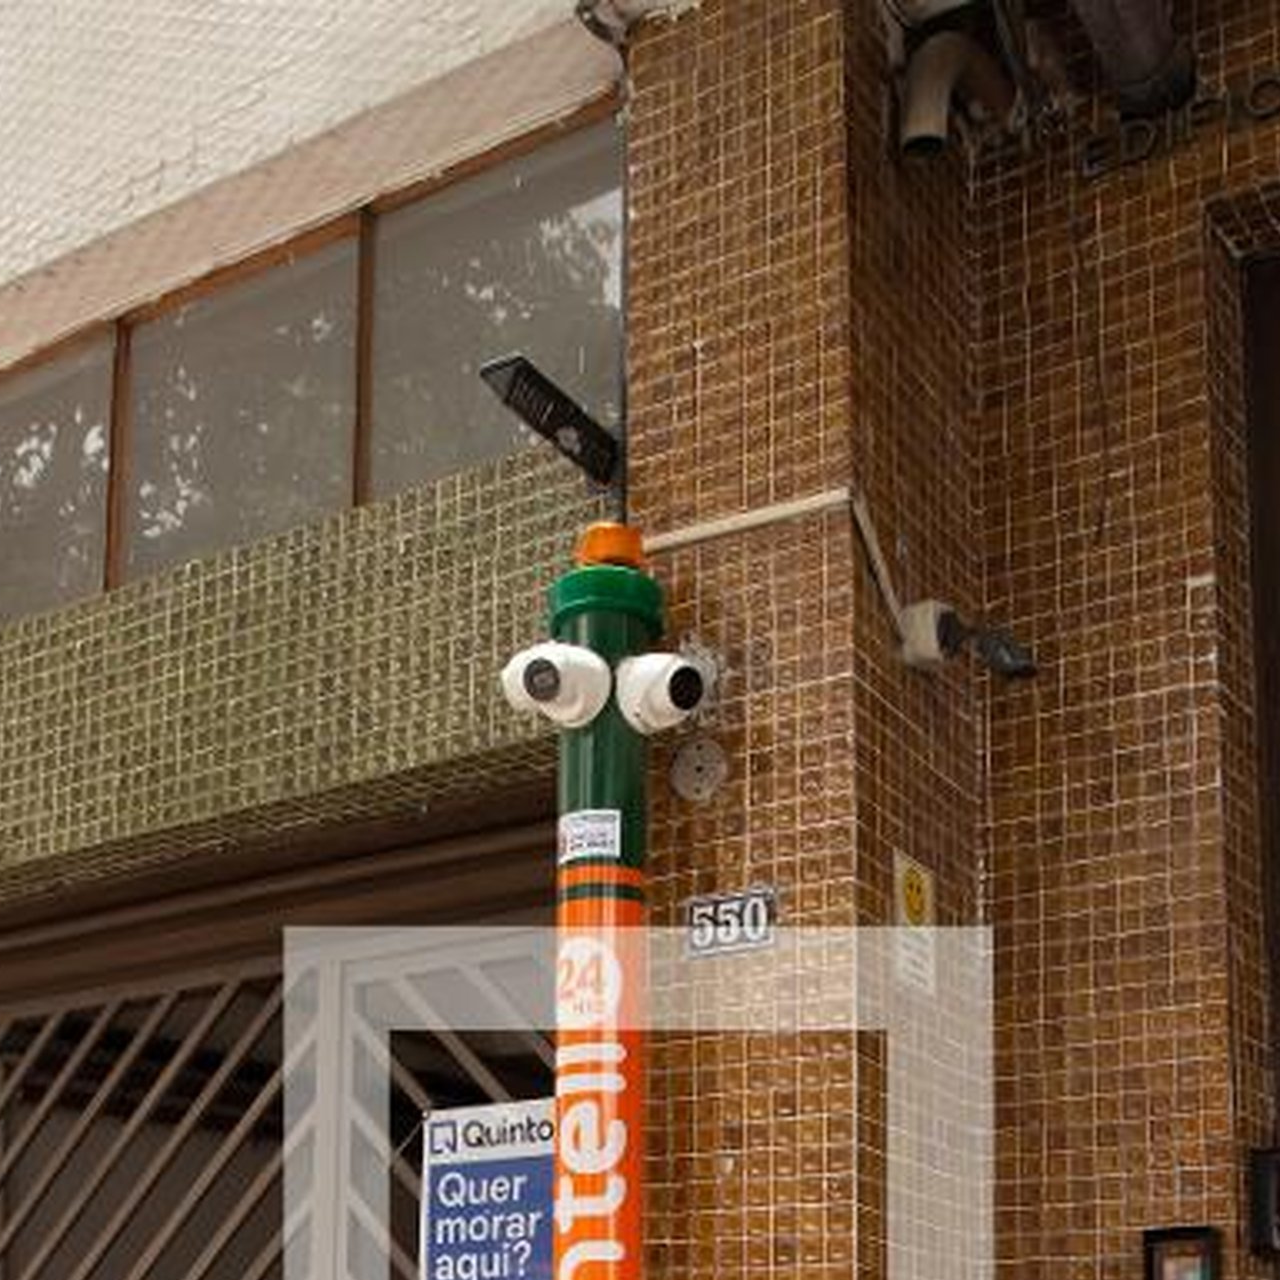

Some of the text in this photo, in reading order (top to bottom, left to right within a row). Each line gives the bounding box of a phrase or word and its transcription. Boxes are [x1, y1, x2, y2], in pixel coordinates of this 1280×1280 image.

[692, 896, 769, 948] 550
[559, 956, 604, 999] 24
[462, 1115, 555, 1148] Quinto
[438, 1171, 528, 1208] Quer
[435, 1211, 543, 1245] morar
